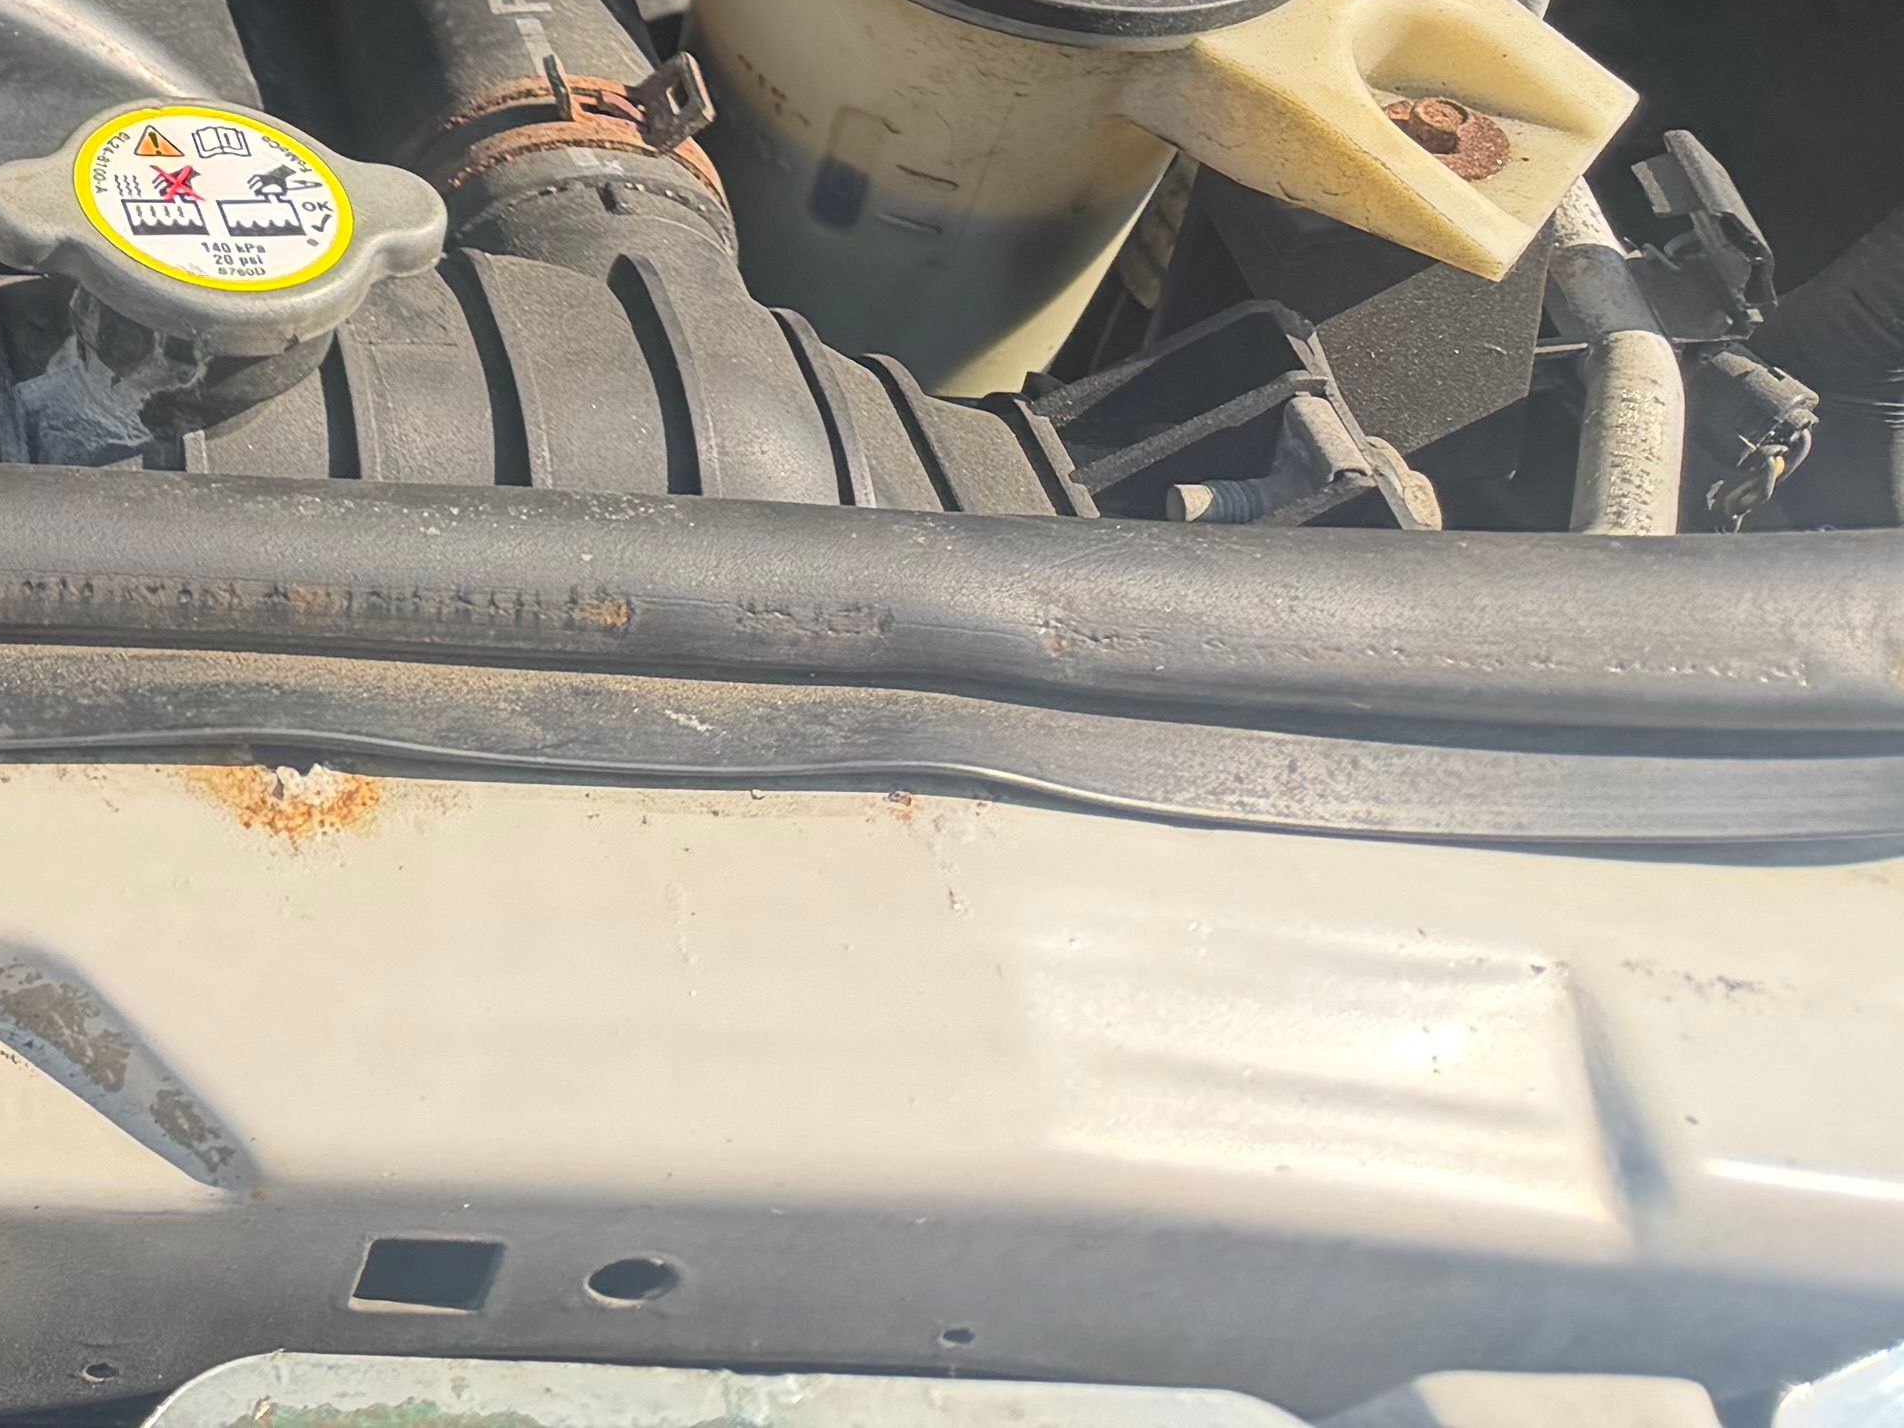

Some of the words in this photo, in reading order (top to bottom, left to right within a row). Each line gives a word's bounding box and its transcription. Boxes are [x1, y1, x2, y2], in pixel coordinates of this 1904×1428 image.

[301, 200, 334, 213] OK
[201, 242, 231, 253] 140
[235, 242, 266, 254] kPa
[213, 254, 234, 265] 20
[239, 255, 264, 267] psi
